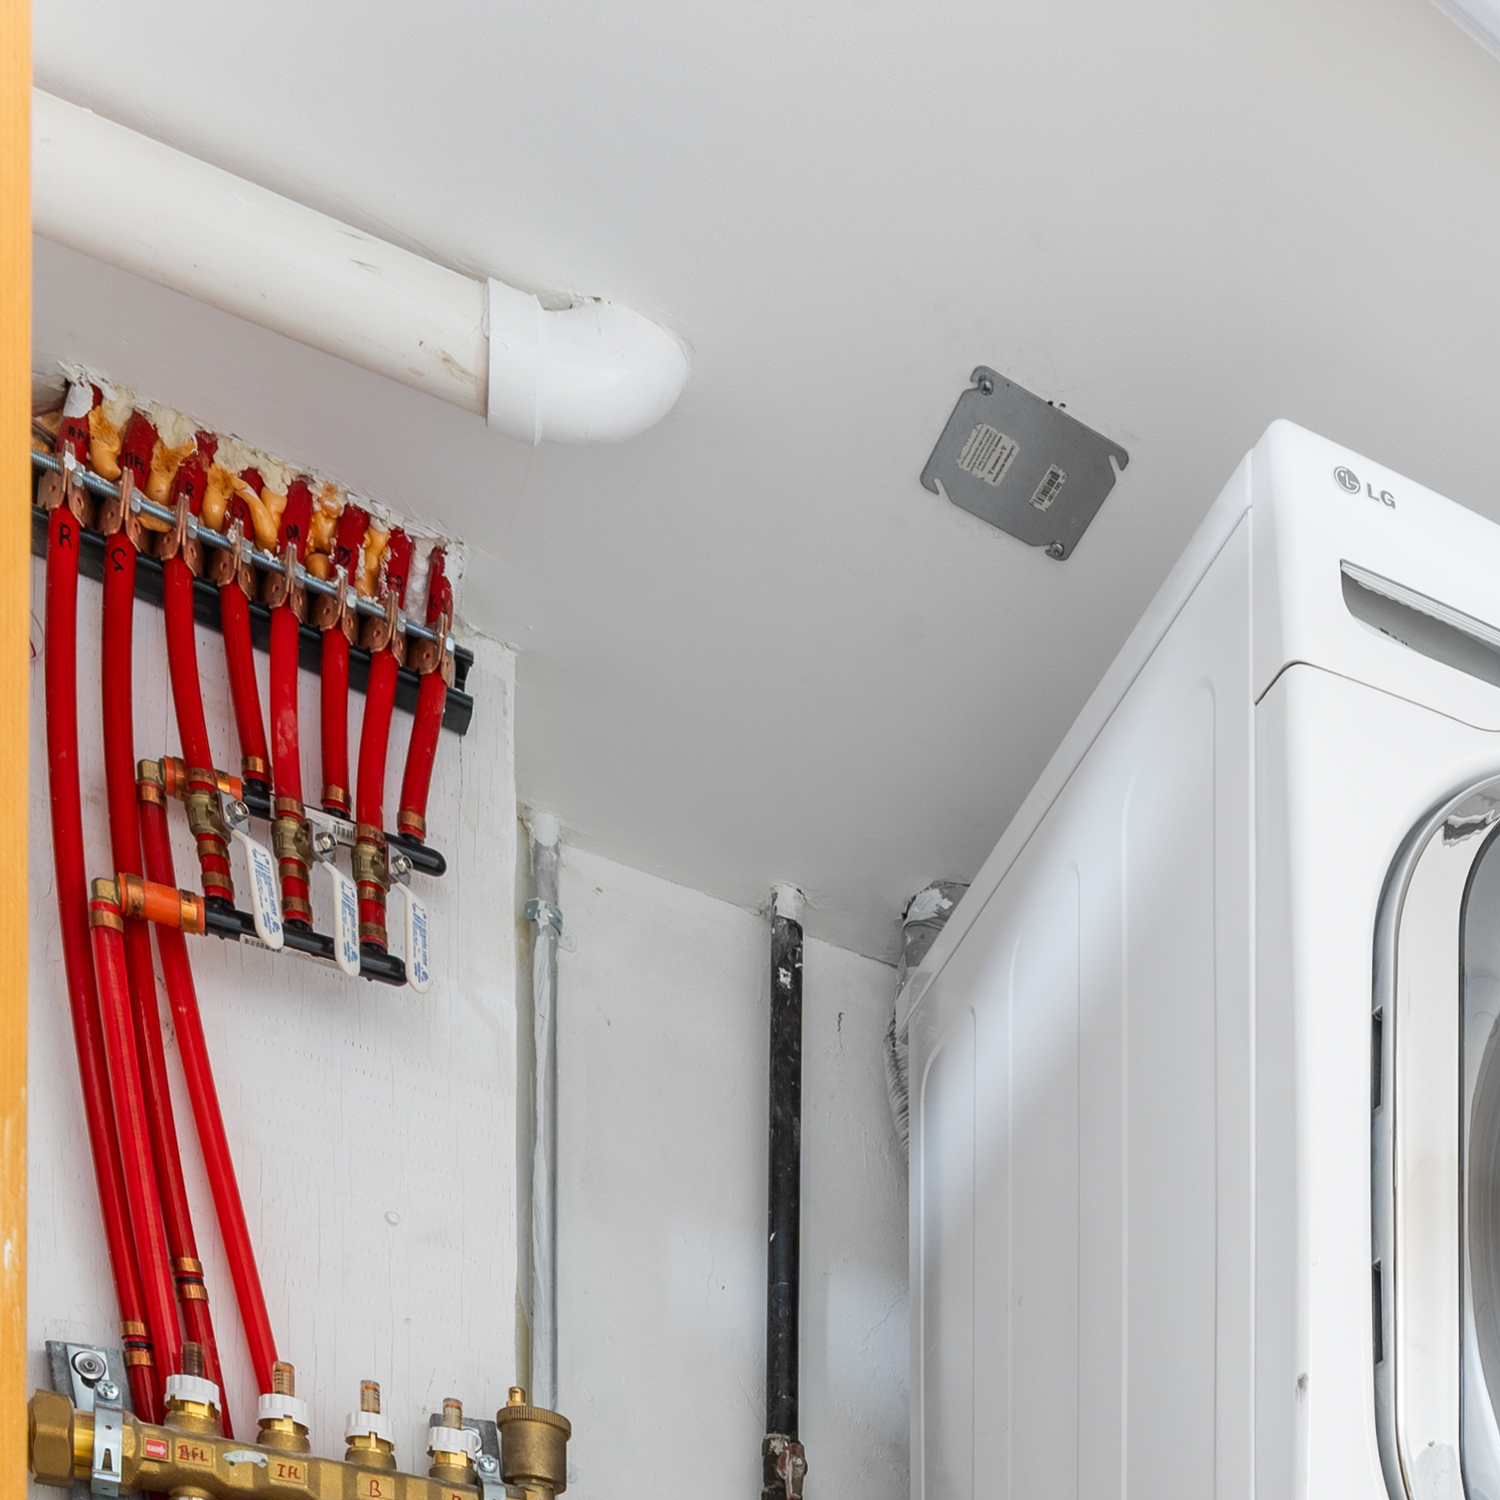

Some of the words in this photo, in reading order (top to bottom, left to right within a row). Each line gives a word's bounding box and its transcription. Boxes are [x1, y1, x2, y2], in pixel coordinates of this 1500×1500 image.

[1366, 483, 1396, 509] LG
[59, 522, 72, 549] R
[286, 524, 300, 541] DR
[370, 1479, 382, 1498] B
